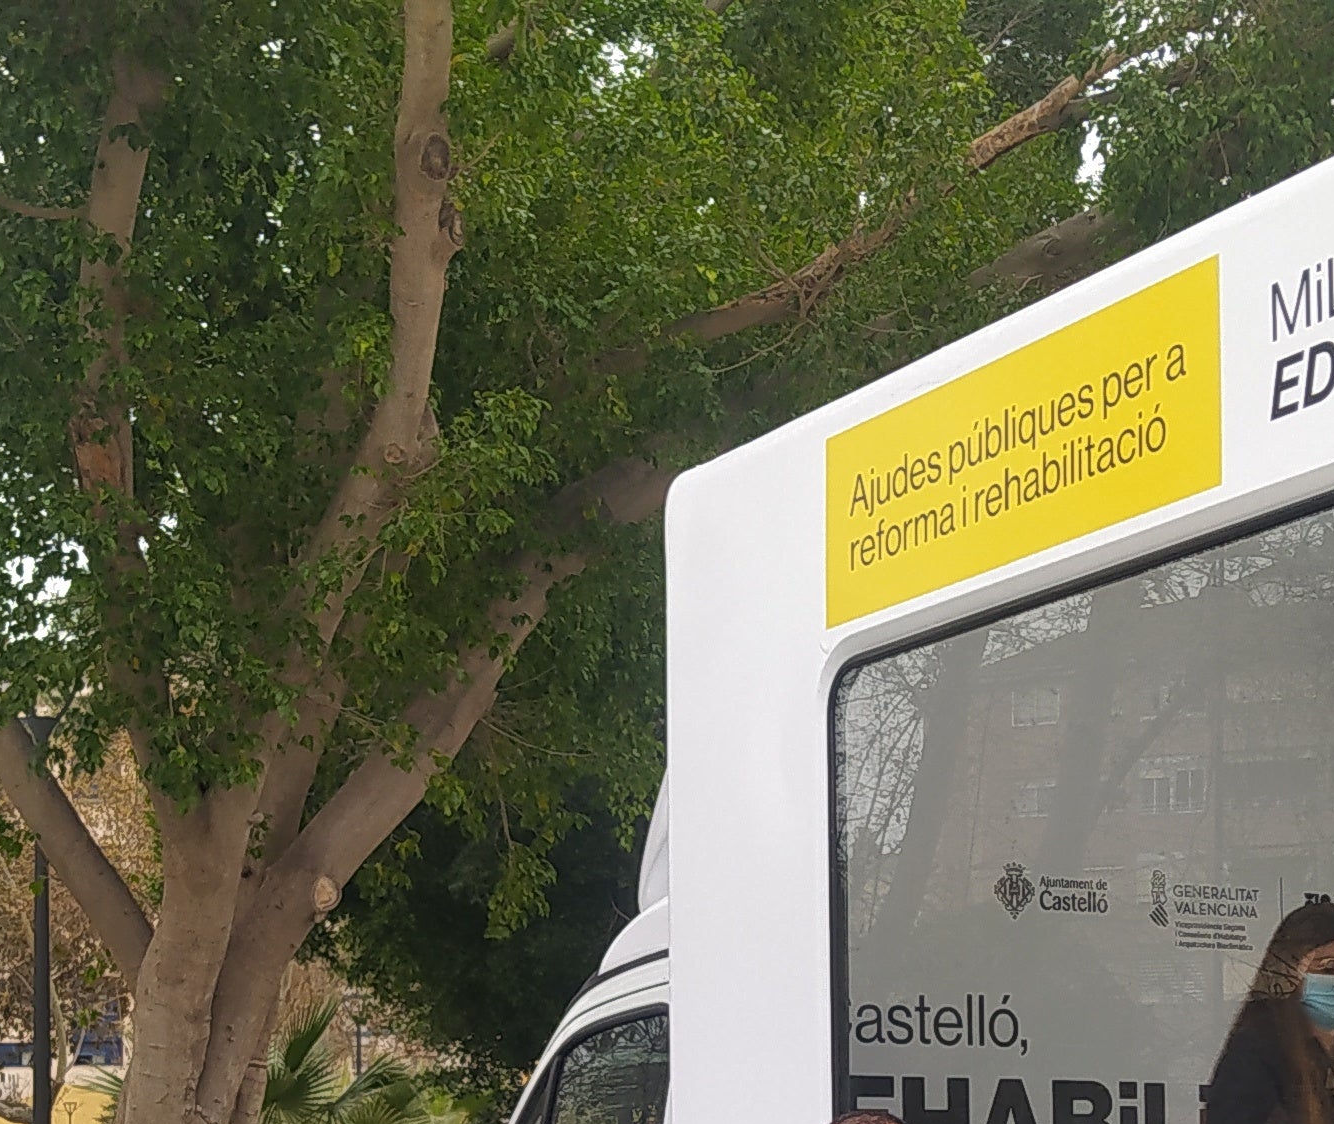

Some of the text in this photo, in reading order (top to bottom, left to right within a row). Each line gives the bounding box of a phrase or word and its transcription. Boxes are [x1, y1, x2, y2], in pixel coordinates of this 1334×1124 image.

[849, 344, 1187, 518] Ajudes públiques per a
[850, 416, 1167, 571] reforma i rehabilitació
[1038, 875, 1108, 892] Ajuntament de
[1172, 884, 1260, 902] GENERALITAT
[1038, 889, 1109, 914] Castelló
[1172, 902, 1259, 919] VALENCIANA
[848, 994, 1029, 1056] astelló,
